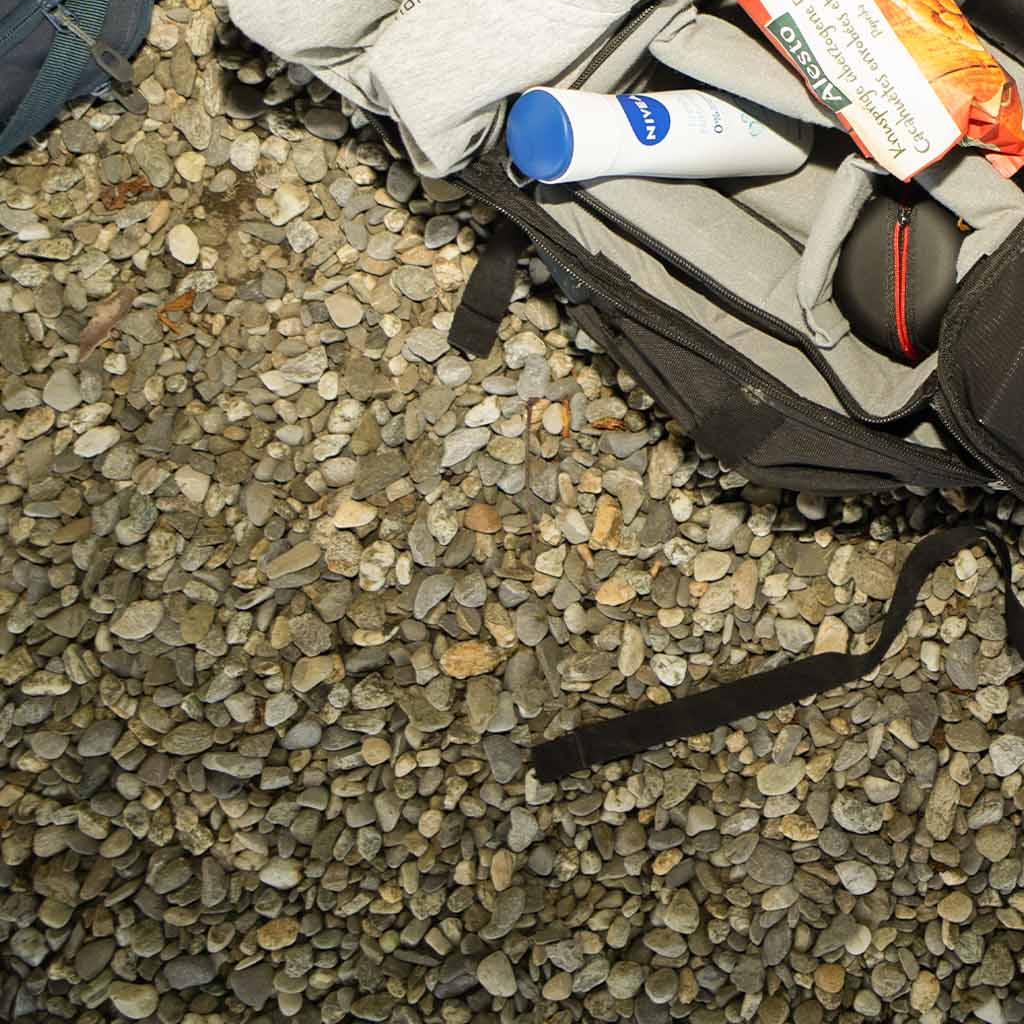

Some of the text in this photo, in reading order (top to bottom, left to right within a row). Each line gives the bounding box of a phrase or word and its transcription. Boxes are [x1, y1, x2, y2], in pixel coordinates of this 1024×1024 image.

[780, 26, 842, 101] Alesto
[806, 5, 857, 83] überzogene
[838, 12, 878, 72] enrobées
[856, 85, 907, 159] Knusprige
[875, 73, 931, 154] Cacahuètes
